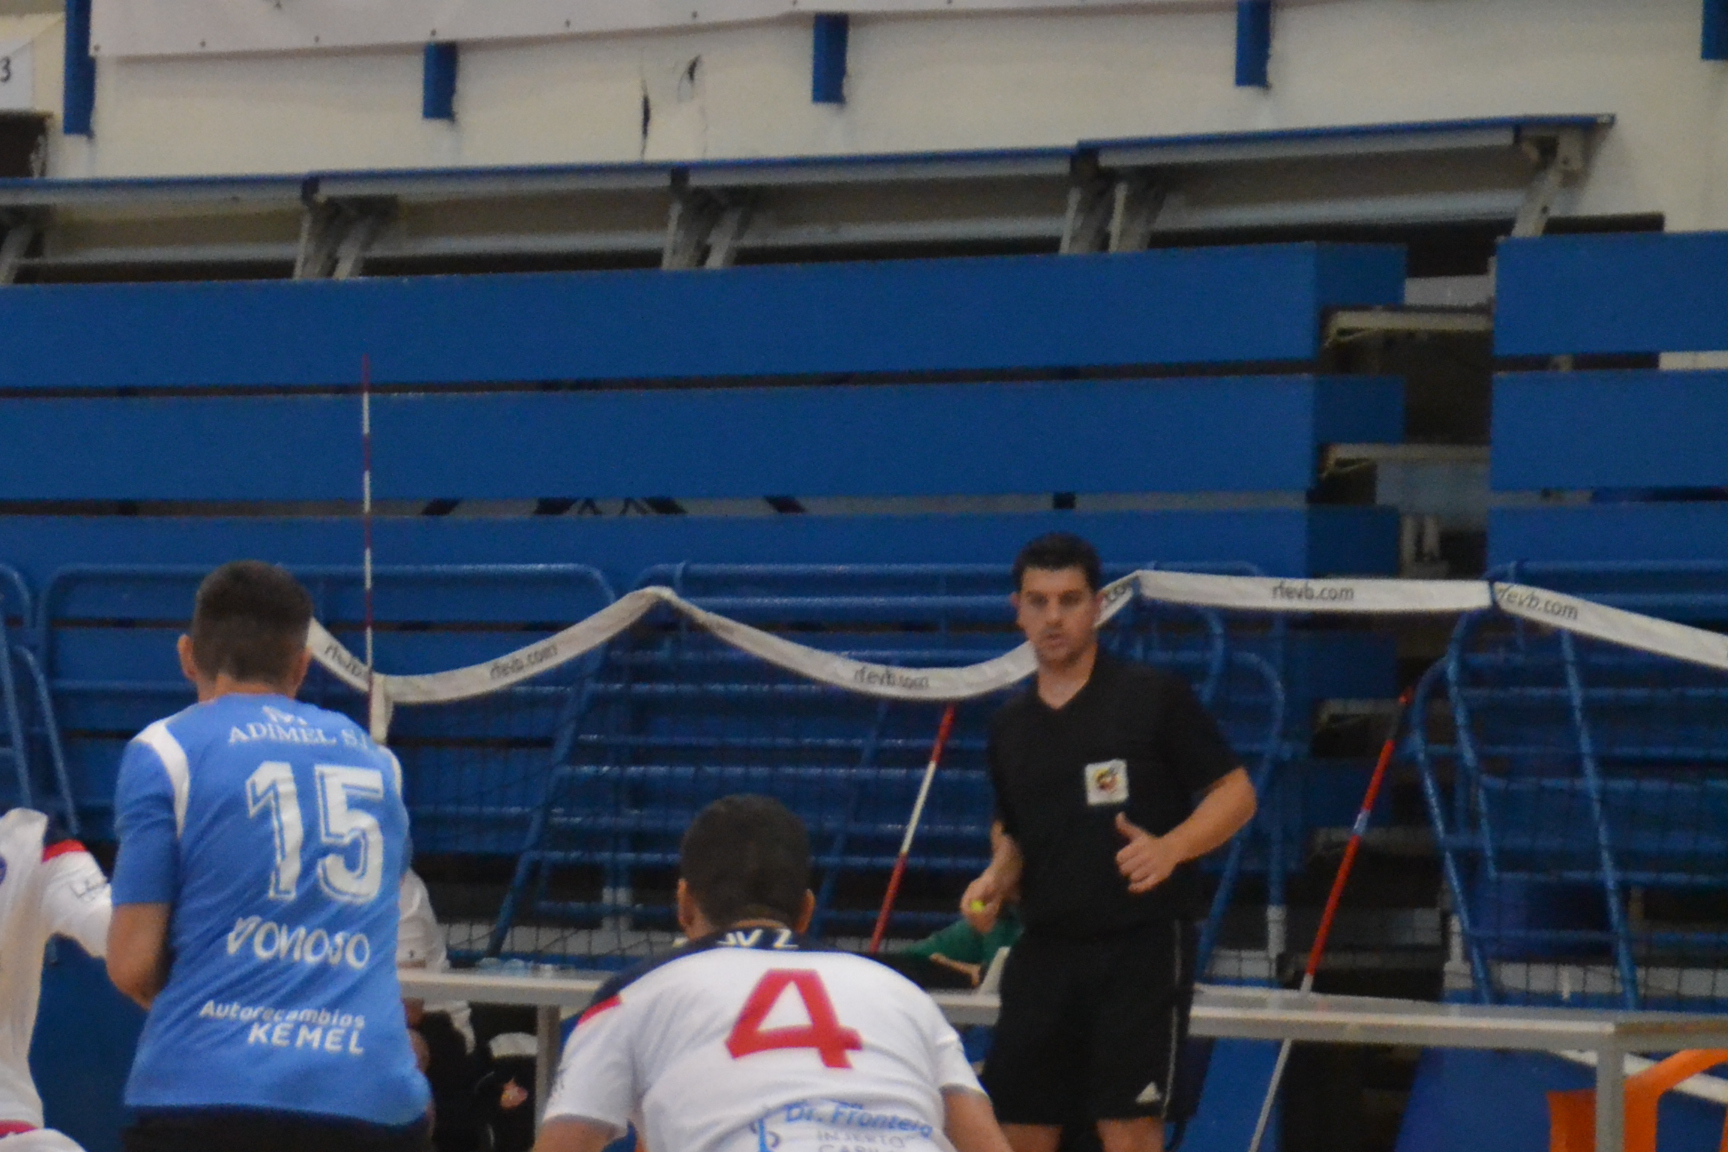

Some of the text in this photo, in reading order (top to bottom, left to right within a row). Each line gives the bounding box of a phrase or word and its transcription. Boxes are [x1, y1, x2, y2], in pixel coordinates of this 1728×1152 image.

[0, 56, 11, 83] 3
[229, 722, 337, 746] ADIMEL
[246, 760, 384, 903] 15
[725, 967, 862, 1068] 4
[247, 1021, 364, 1055] KEMEL
